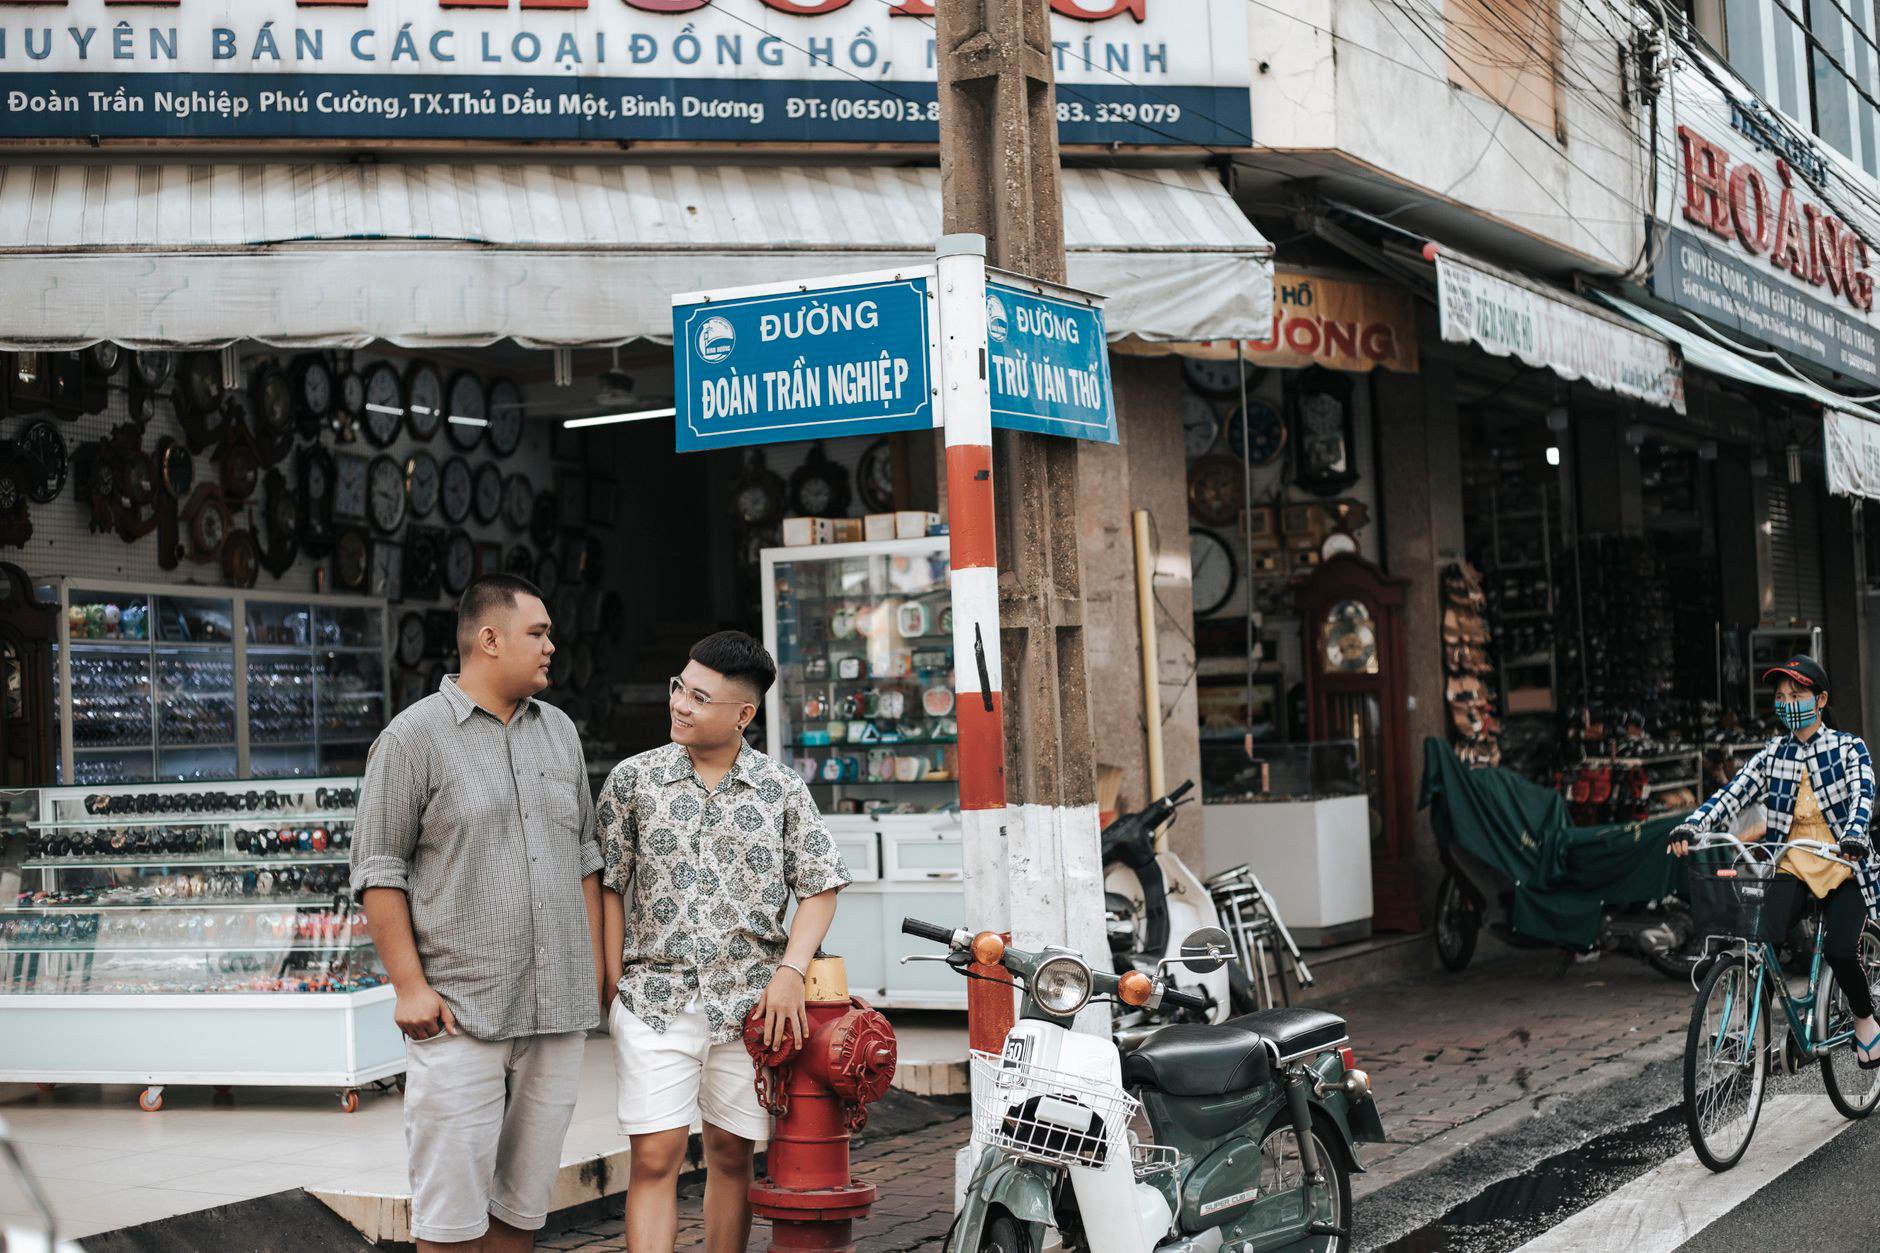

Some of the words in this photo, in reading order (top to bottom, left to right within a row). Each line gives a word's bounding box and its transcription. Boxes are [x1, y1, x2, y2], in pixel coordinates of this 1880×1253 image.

[0, 21, 178, 60] UYÊN
[212, 21, 323, 61] BÁN
[350, 22, 455, 62] CÁC
[481, 31, 606, 71] LOẠI
[629, 23, 784, 67] ĐỒNG
[808, 26, 892, 75] HỒ,
[1051, 34, 1168, 74] TÍNH
[7, 89, 79, 112] Đoàn
[88, 86, 144, 112] Trần
[154, 90, 249, 118] Nghiệp
[259, 90, 309, 113] Phú
[502, 87, 552, 114] Dầu
[558, 92, 617, 120] Một,
[621, 94, 675, 117] Bình
[682, 96, 764, 124] Dương
[1678, 124, 1874, 313] HOÀNG
[760, 300, 880, 342] ĐƯỜNG
[1016, 304, 1080, 344] ĐƯỜNG
[702, 366, 757, 420] ĐOÀN
[762, 355, 821, 412] TRẦN
[827, 350, 909, 409] NGHIỆP
[992, 348, 1029, 399] TRỪ
[1031, 356, 1068, 404] VĂN
[1068, 361, 1101, 411] THỐ
[1205, 1198, 1230, 1210] SUPER
